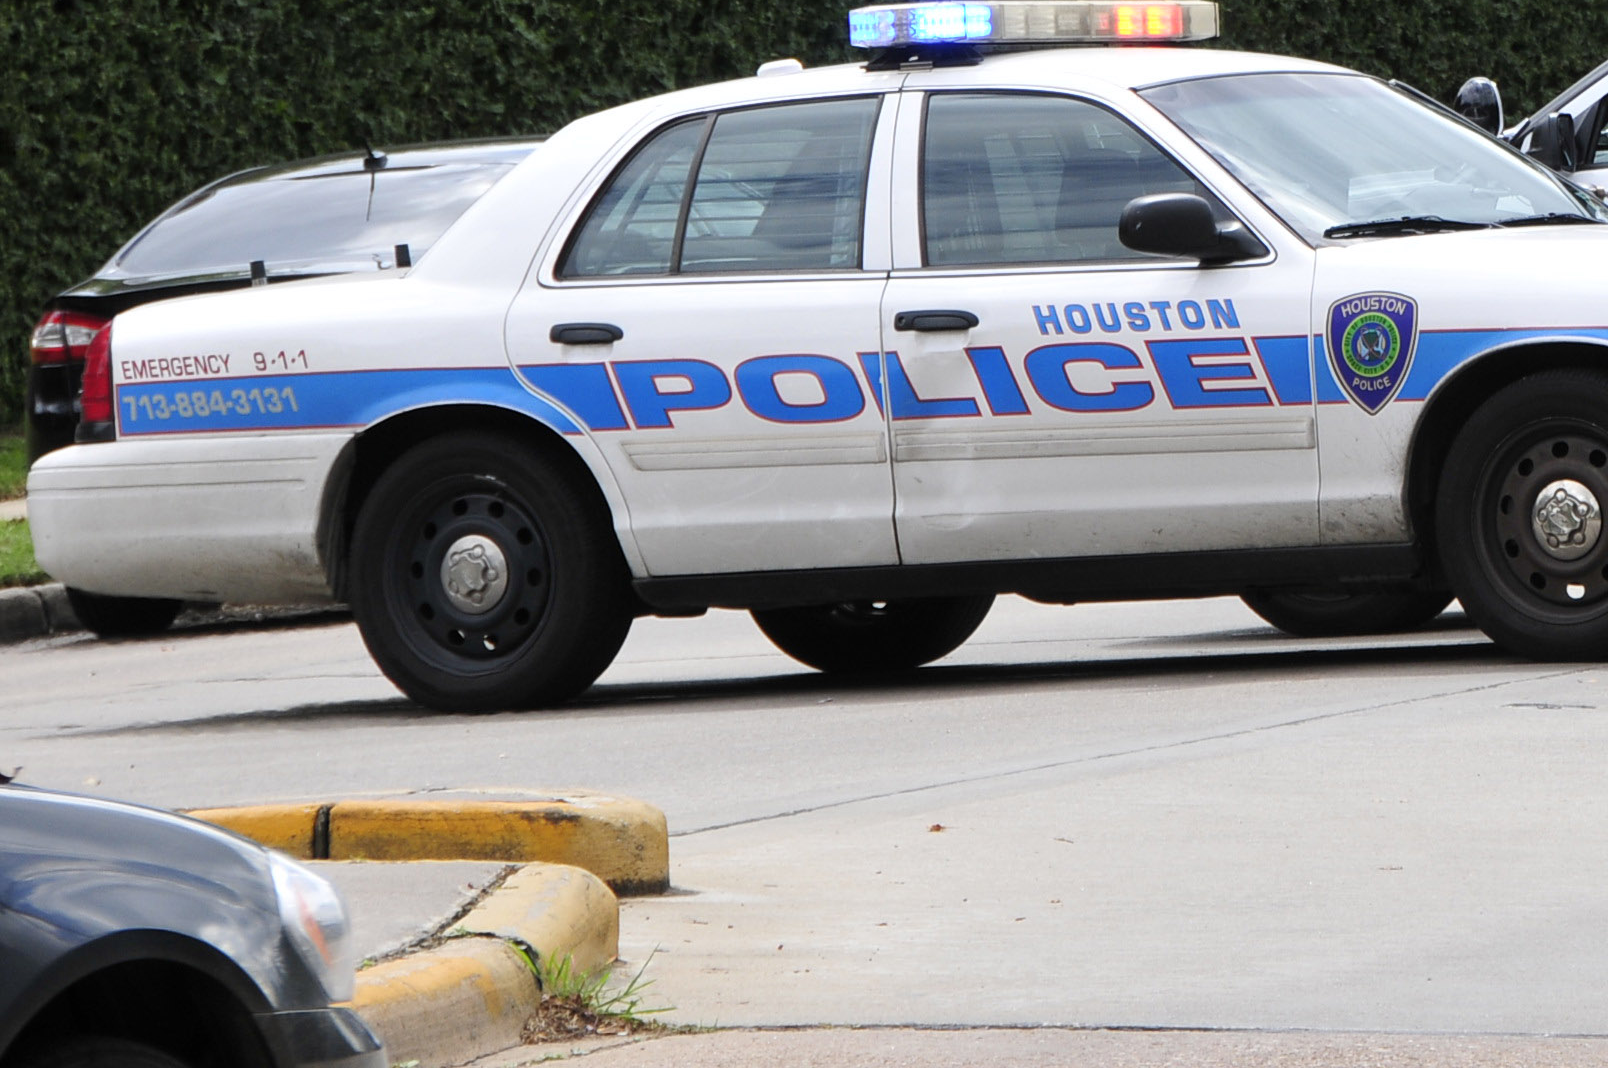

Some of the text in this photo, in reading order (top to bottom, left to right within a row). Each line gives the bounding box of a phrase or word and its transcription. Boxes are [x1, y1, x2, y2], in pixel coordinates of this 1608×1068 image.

[1032, 298, 1241, 336] HOUSTON
[1341, 297, 1407, 317] HOUSTON
[121, 354, 230, 379] EMERGENCY
[611, 335, 1275, 431] POLICE
[1352, 377, 1391, 391] POLICE
[122, 386, 299, 422] 713-884-3131
